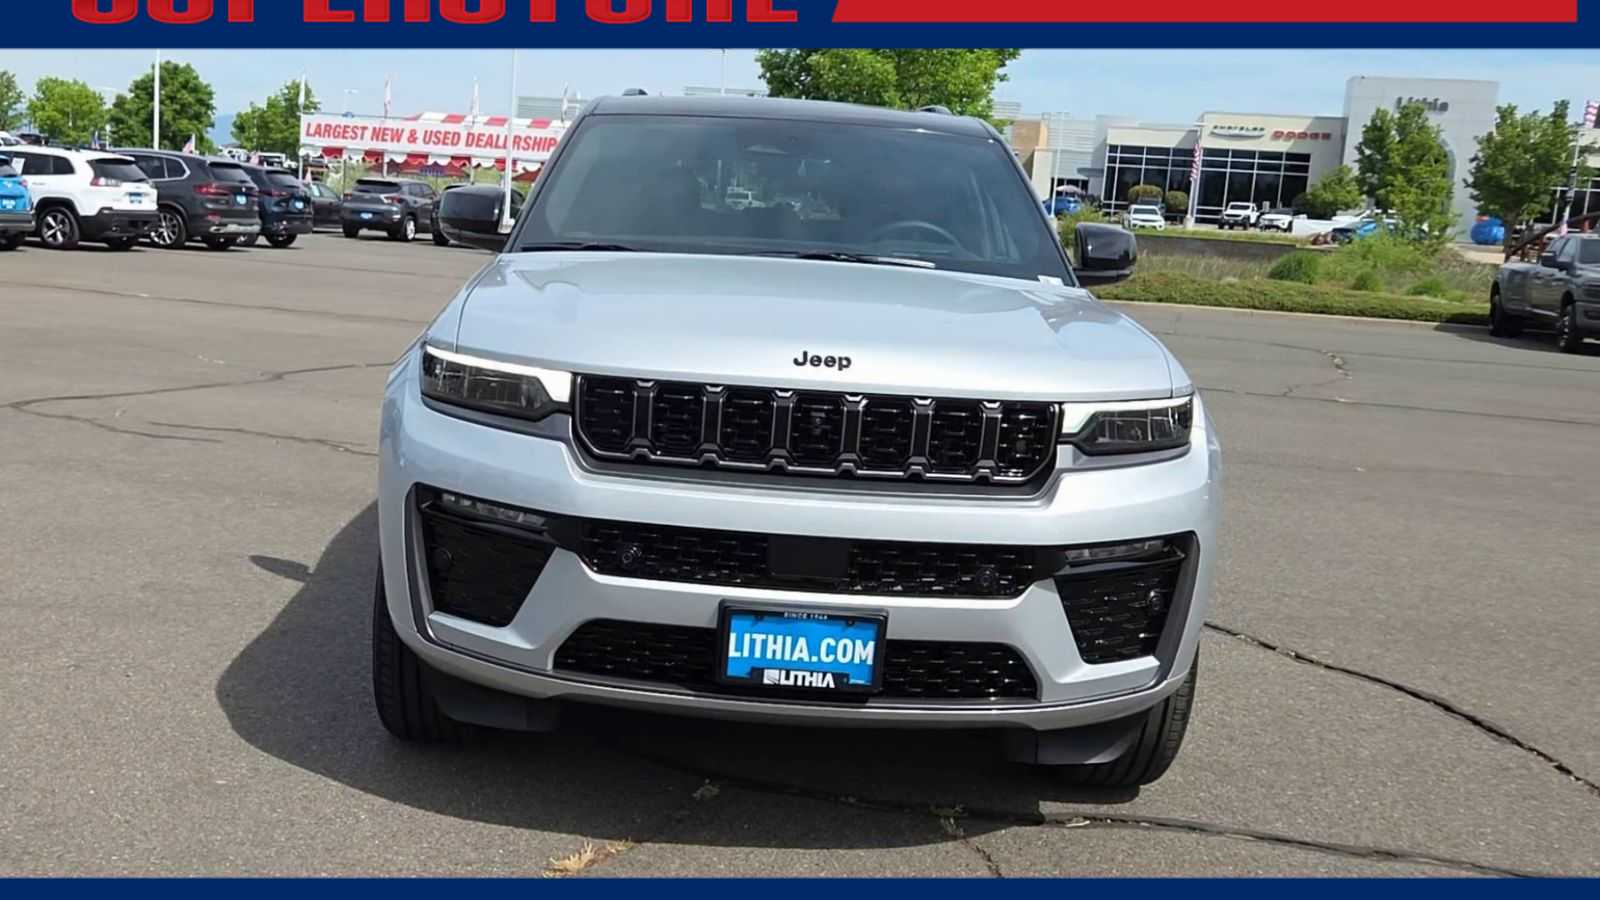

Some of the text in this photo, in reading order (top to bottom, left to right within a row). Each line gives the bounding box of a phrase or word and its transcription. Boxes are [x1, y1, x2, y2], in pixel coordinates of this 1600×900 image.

[305, 122, 368, 141] LARGEST
[370, 127, 404, 144] NEW
[407, 129, 418, 144] &
[422, 130, 461, 147] USED
[1271, 130, 1331, 141] DODGE
[793, 350, 852, 371] Jeep
[728, 632, 875, 665] LITHIA.COM
[780, 670, 835, 688] LITHIA
